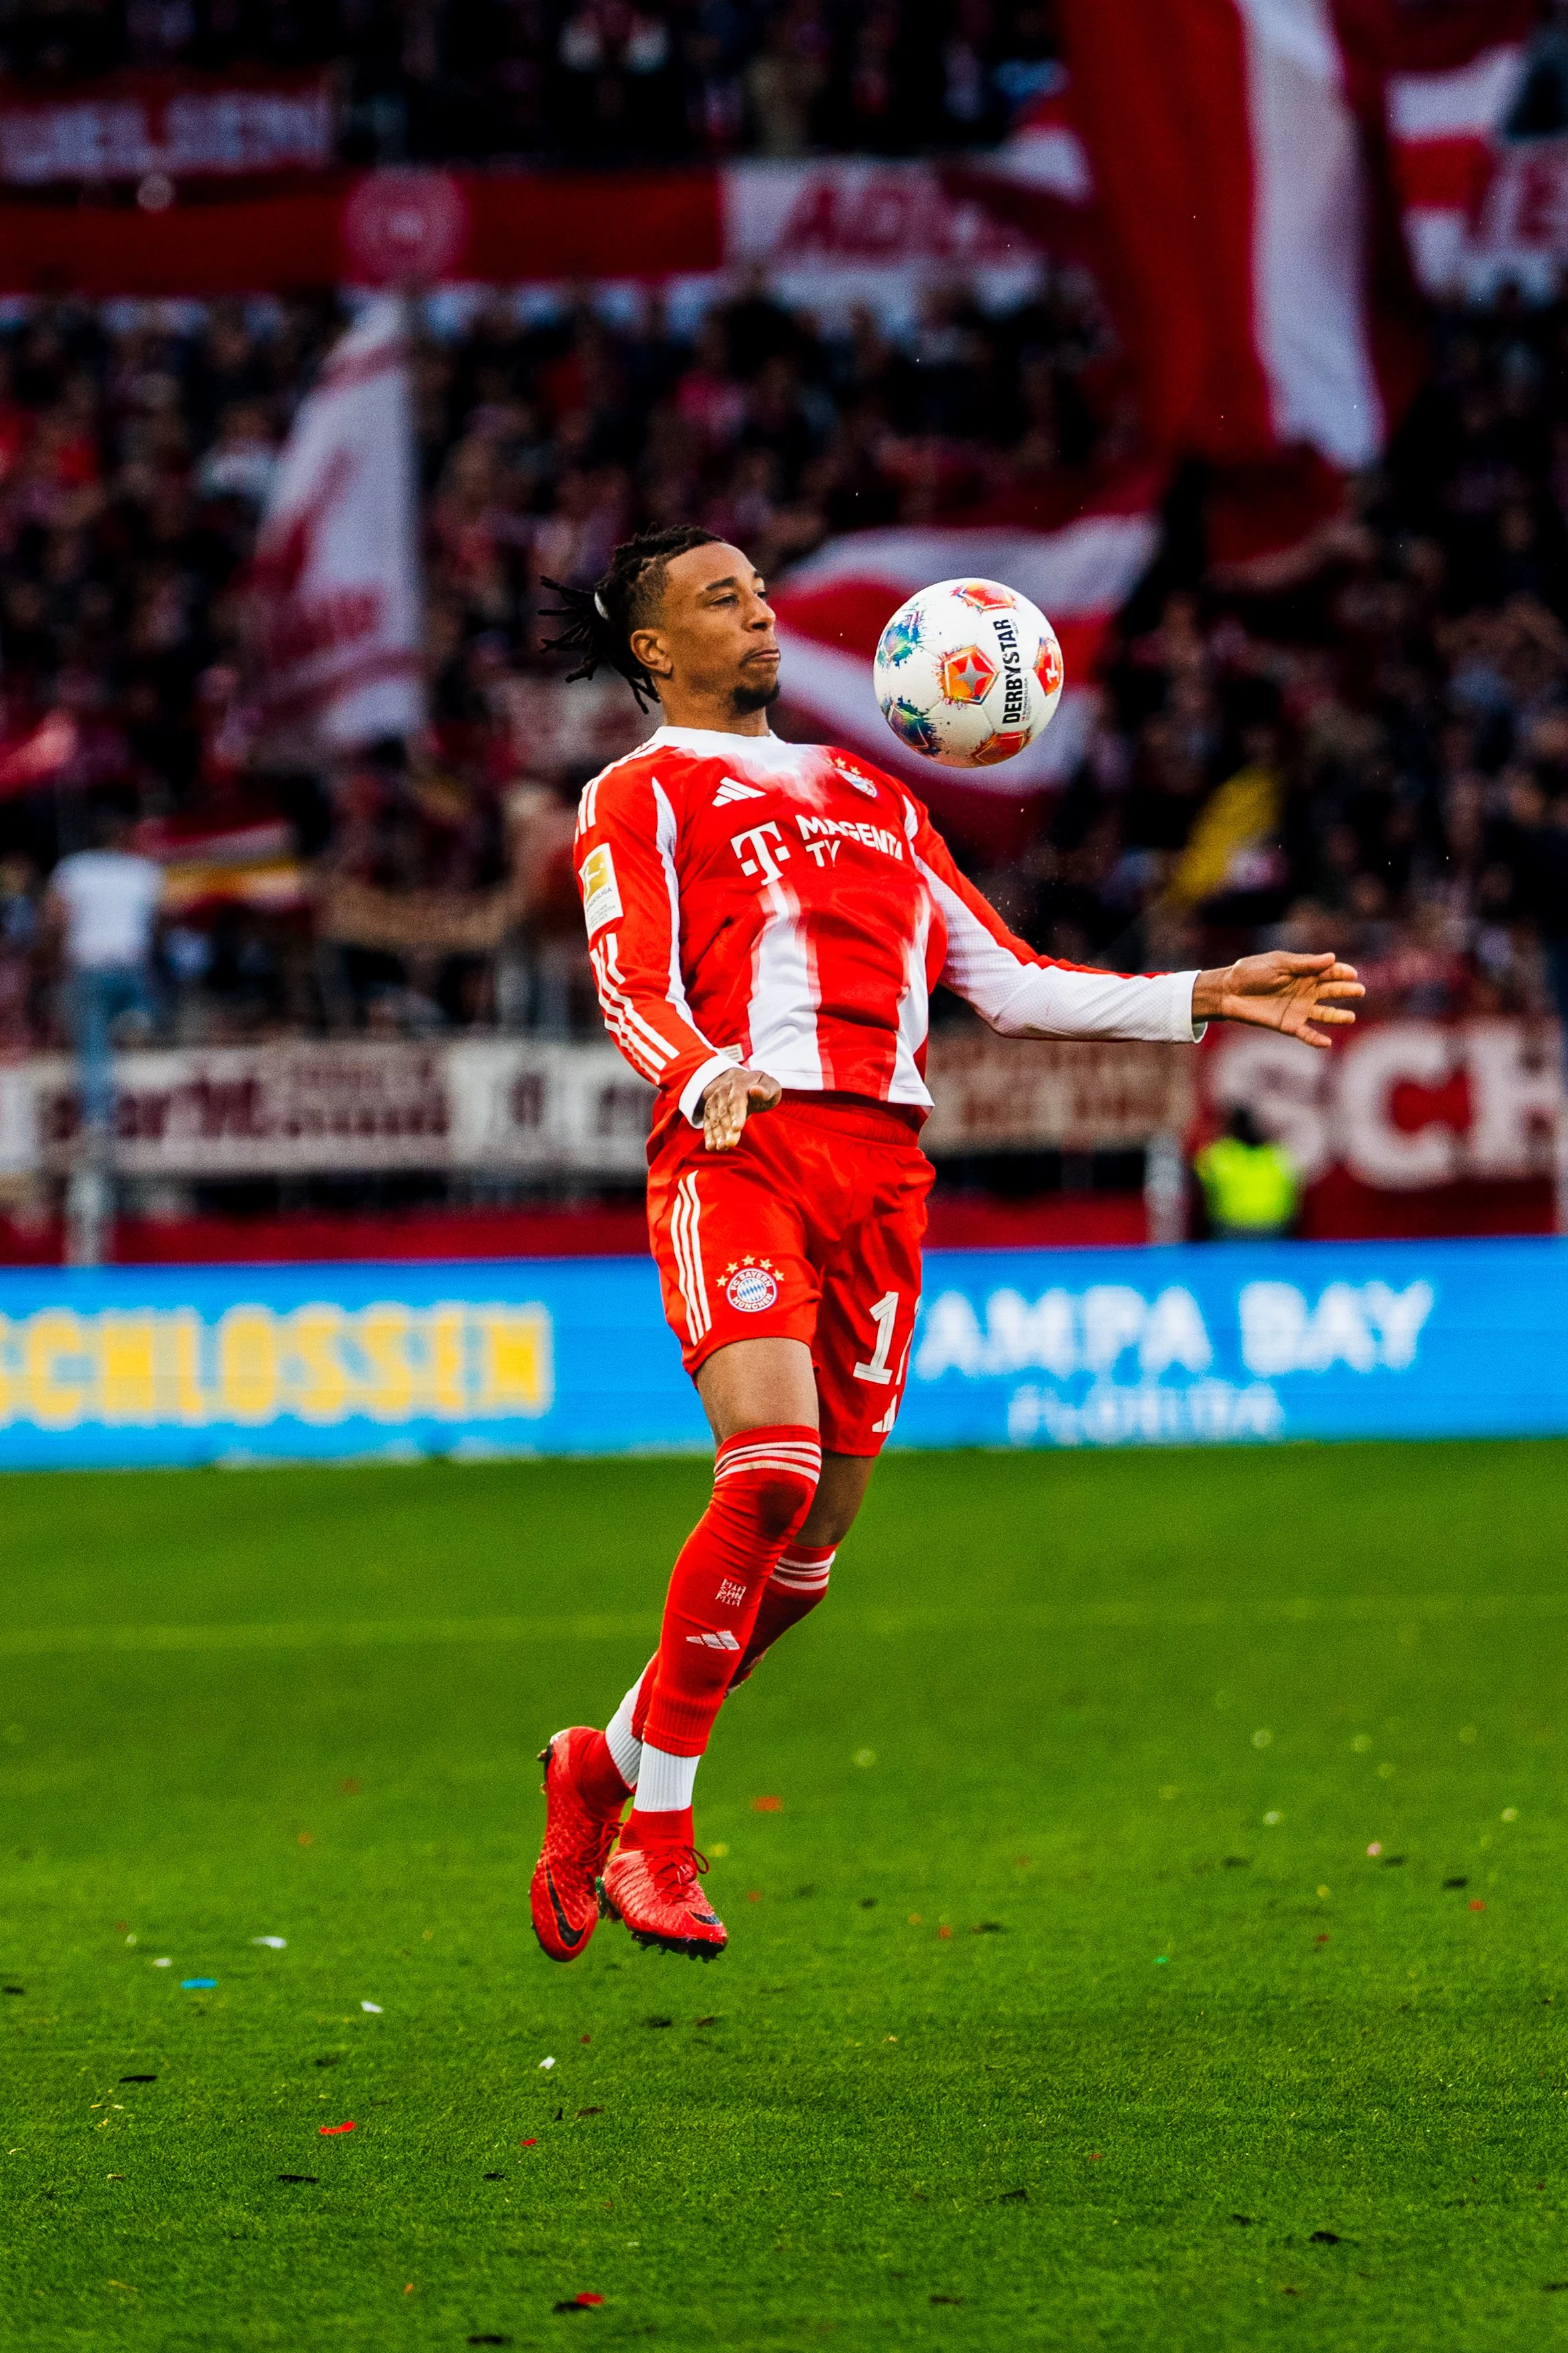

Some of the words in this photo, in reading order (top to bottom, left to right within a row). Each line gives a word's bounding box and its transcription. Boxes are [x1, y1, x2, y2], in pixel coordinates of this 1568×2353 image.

[993, 619, 1023, 724] DERBYSTAR
[730, 821, 790, 886] T
[795, 815, 903, 861] MAGENTA
[805, 839, 841, 867] TV
[730, 1279, 740, 1291] FC
[738, 1271, 773, 1287] BAYERN
[853, 1291, 917, 1385] 1
[914, 1285, 1213, 1381] AMPA
[1238, 1280, 1435, 1378] BAY
[0, 1305, 549, 1427] CHLOSSEN
[714, 1592, 741, 1607] MIA
[720, 1585, 744, 1600] SAN
[722, 1578, 747, 1592] MIA
